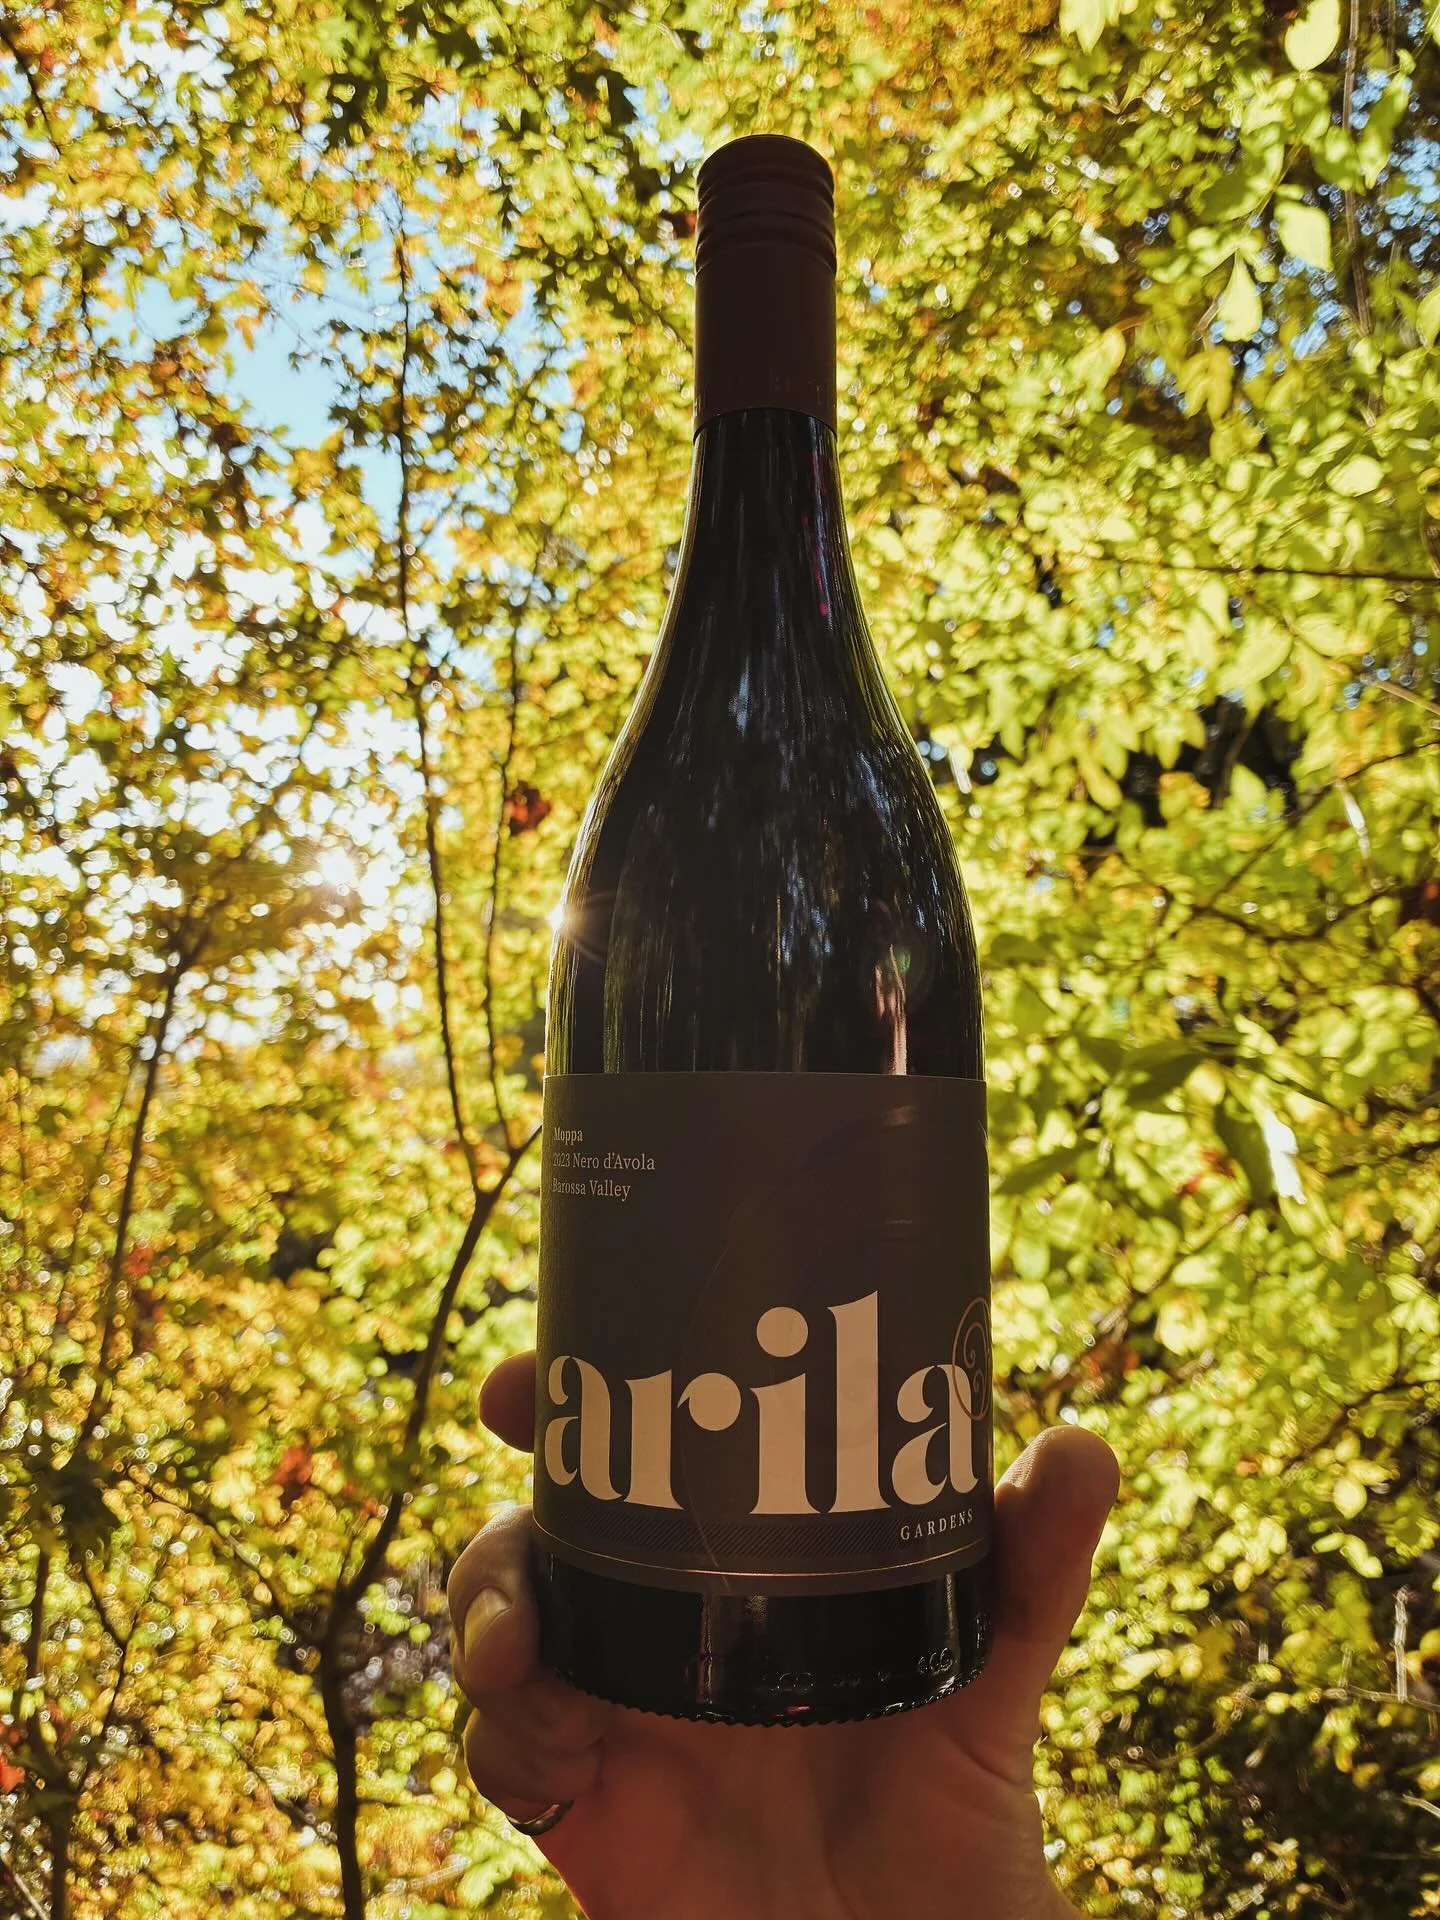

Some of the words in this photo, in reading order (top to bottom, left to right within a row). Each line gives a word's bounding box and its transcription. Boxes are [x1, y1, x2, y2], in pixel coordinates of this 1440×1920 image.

[553, 1127, 583, 1146] Moppa
[553, 1152, 570, 1167] 2023
[573, 1152, 600, 1168] Nero
[603, 1152, 656, 1170] d’Avola
[552, 1178, 586, 1195] Barossa
[589, 1180, 631, 1202] Valley
[544, 1290, 979, 1514] arila
[900, 1508, 973, 1541] GARDENS
